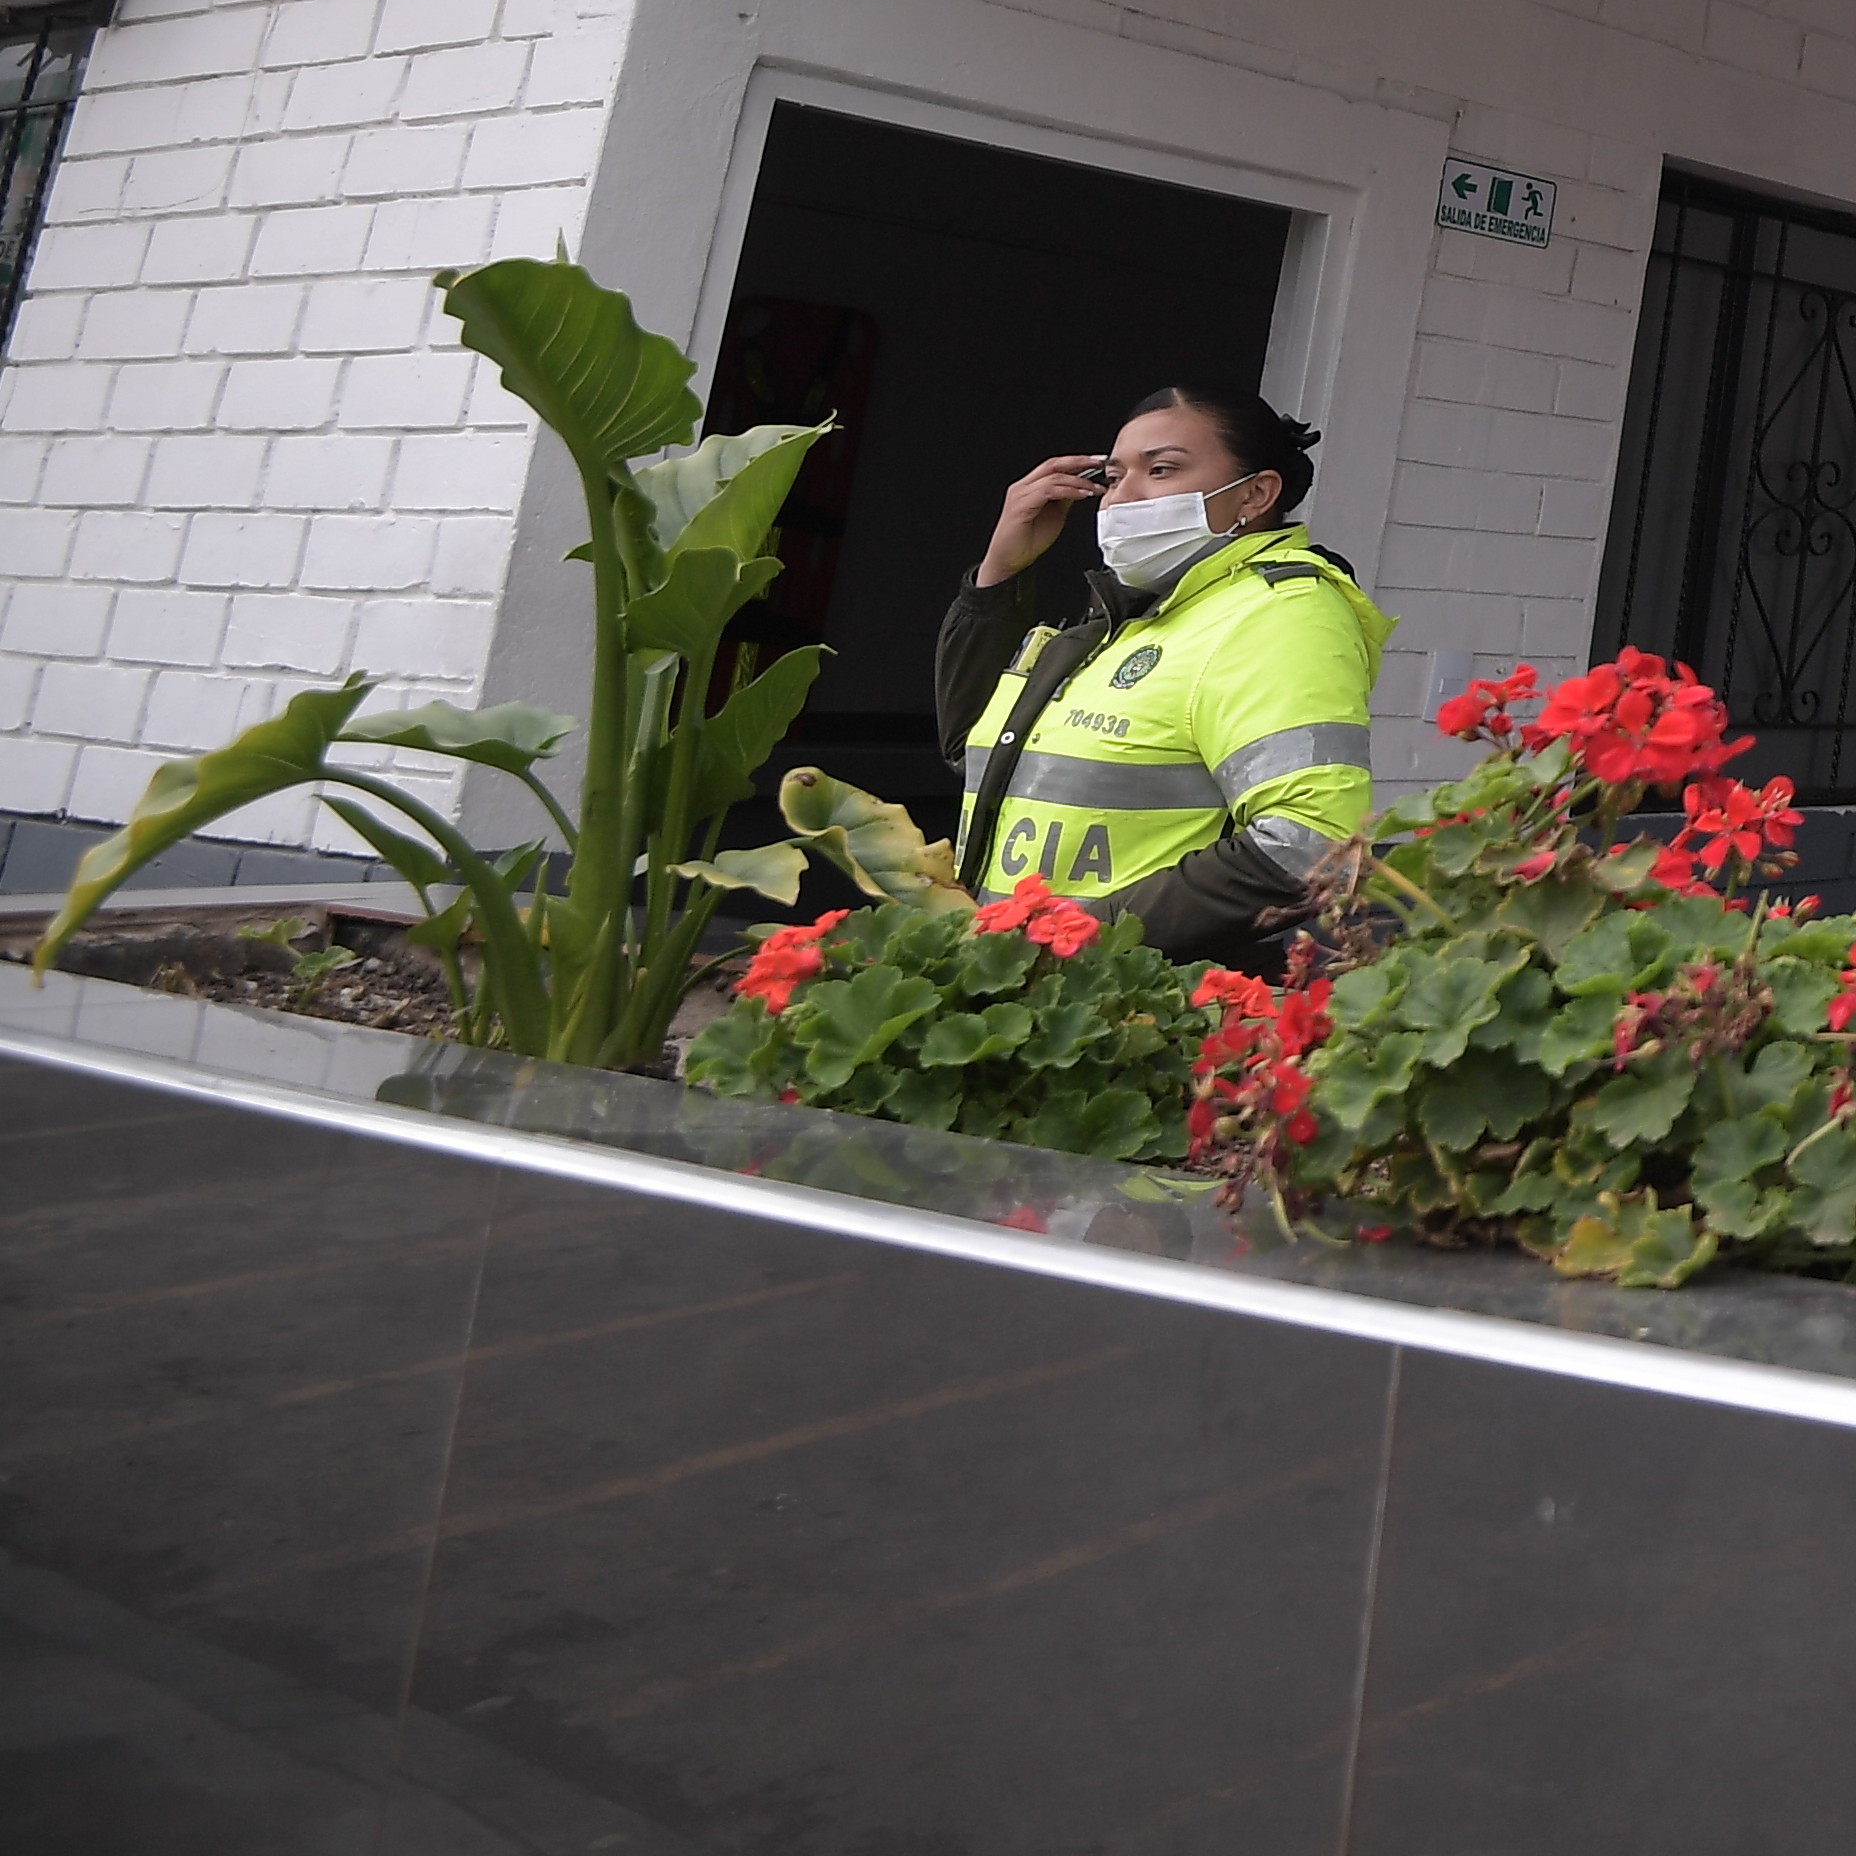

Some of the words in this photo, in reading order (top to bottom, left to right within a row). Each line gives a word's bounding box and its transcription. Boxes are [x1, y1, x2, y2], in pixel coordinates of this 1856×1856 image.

[1440, 205, 1473, 229] SALIDA
[1473, 212, 1487, 231] DE
[1488, 215, 1546, 243] EMERGENCIA
[1063, 708, 1131, 738] 704938
